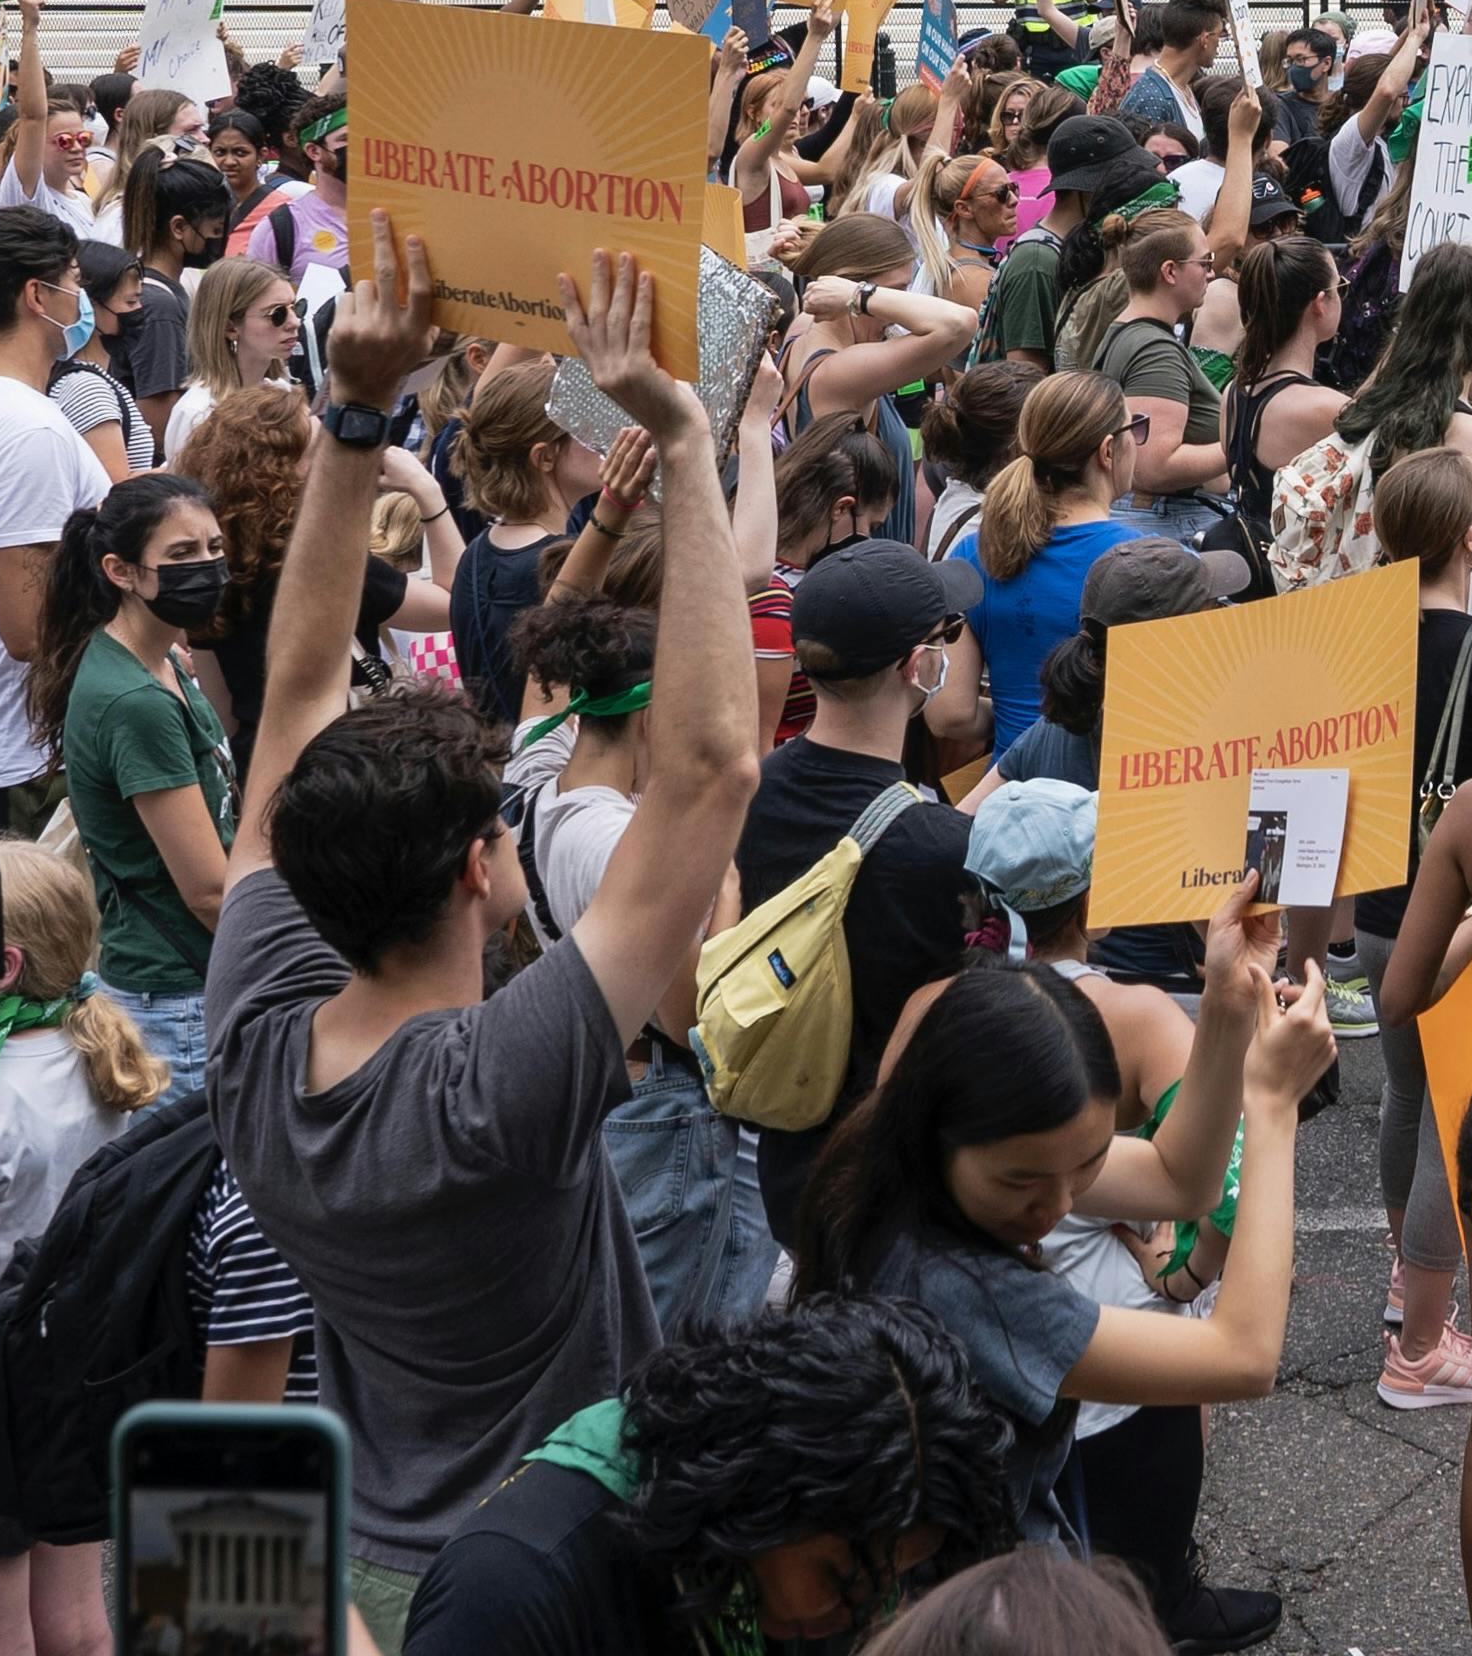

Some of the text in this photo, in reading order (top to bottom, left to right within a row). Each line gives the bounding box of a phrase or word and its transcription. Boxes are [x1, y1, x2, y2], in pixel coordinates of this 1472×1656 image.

[141, 32, 170, 77] MY
[362, 137, 684, 225] LIBERATE ABORTION
[1433, 142, 1470, 194] THE
[1408, 201, 1471, 261] COURT
[432, 279, 567, 321] iberateAbortio
[1117, 700, 1401, 791] LIBERATE ABORTION
